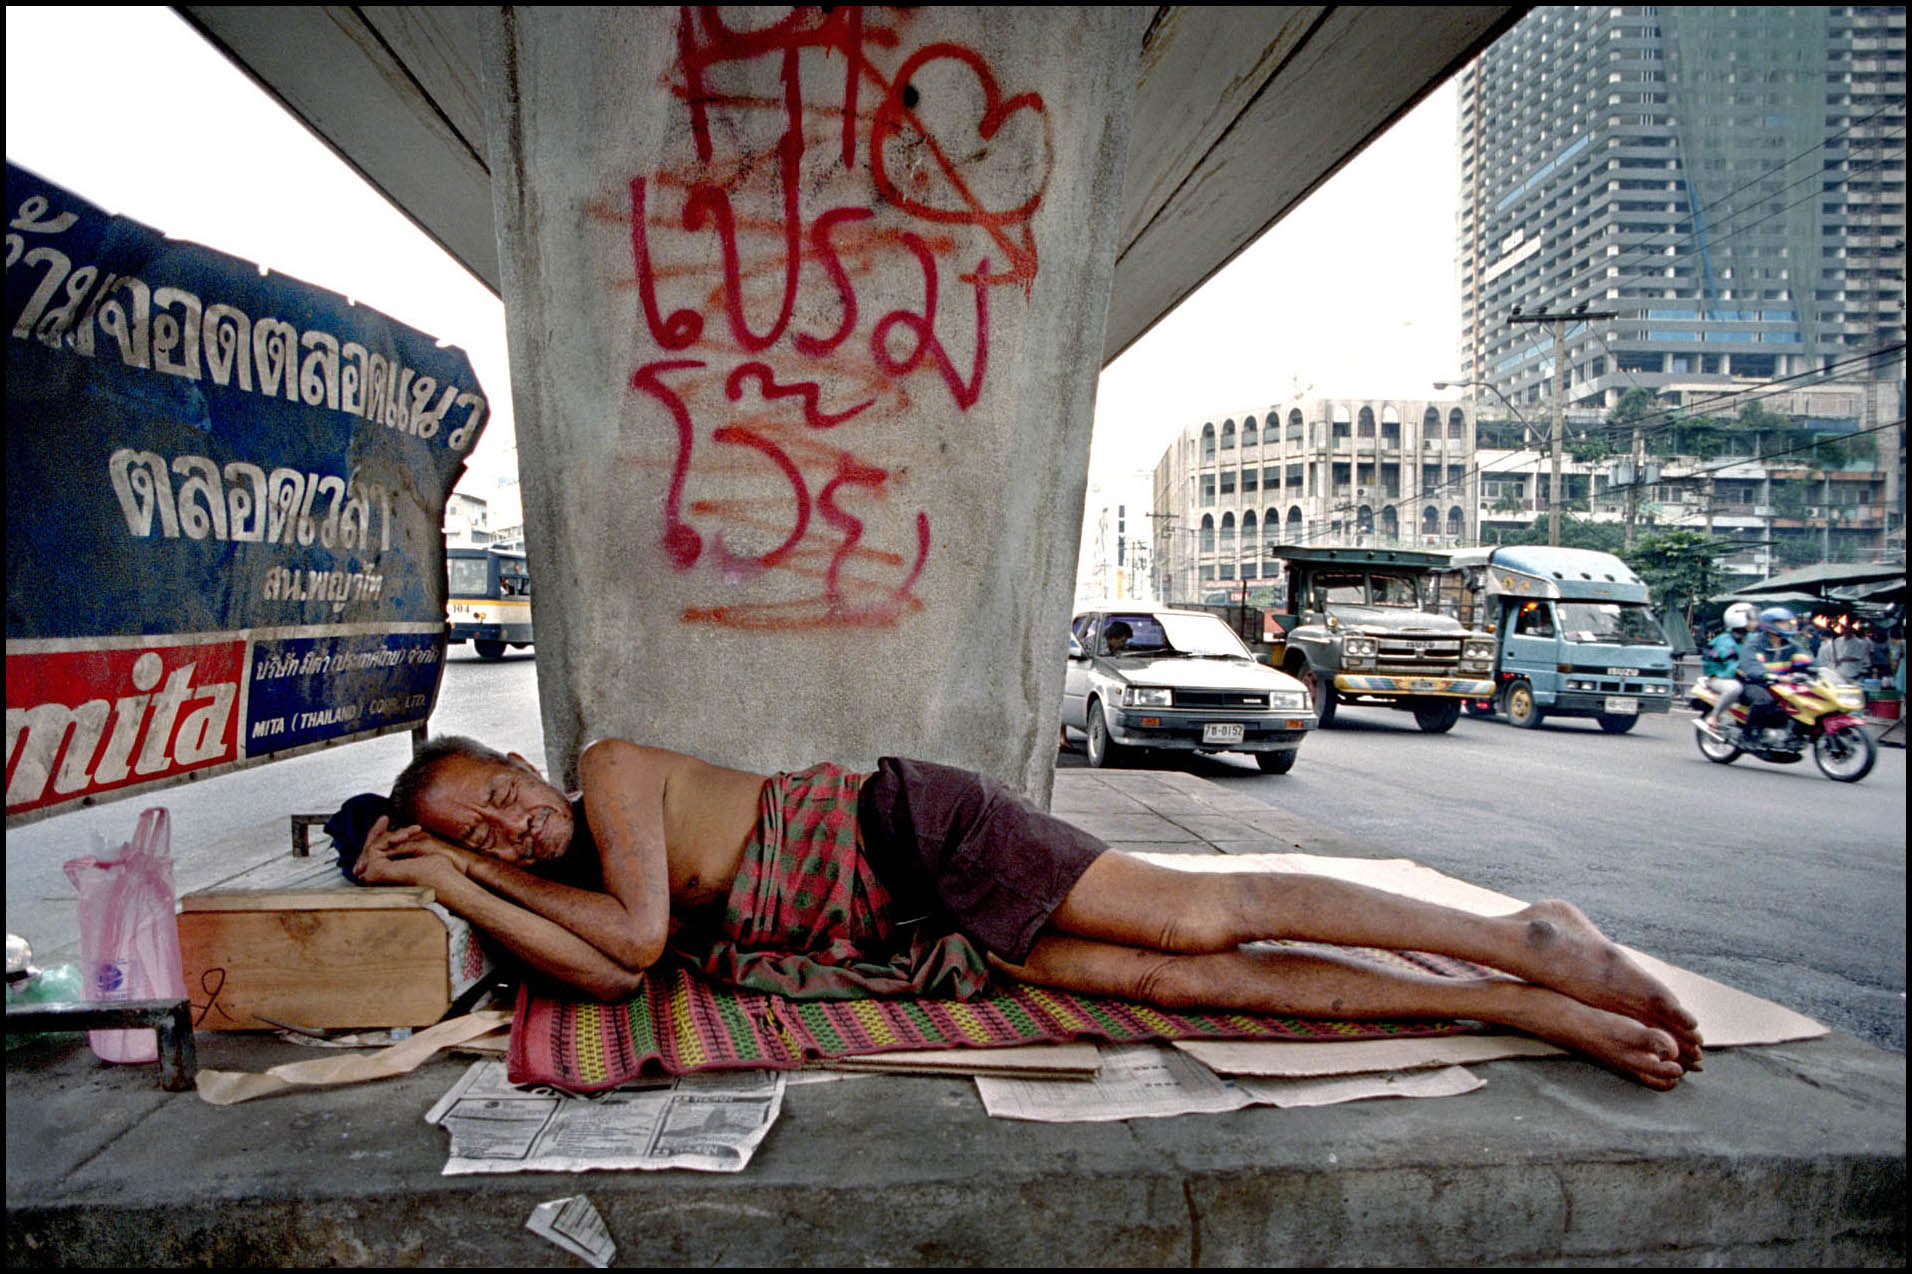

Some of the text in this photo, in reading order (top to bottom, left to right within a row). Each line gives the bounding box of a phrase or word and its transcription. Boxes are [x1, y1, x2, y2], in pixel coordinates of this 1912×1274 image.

[110, 448, 390, 552] ตลอดเวลา
[6, 652, 237, 806] mita
[252, 717, 285, 739] MITA
